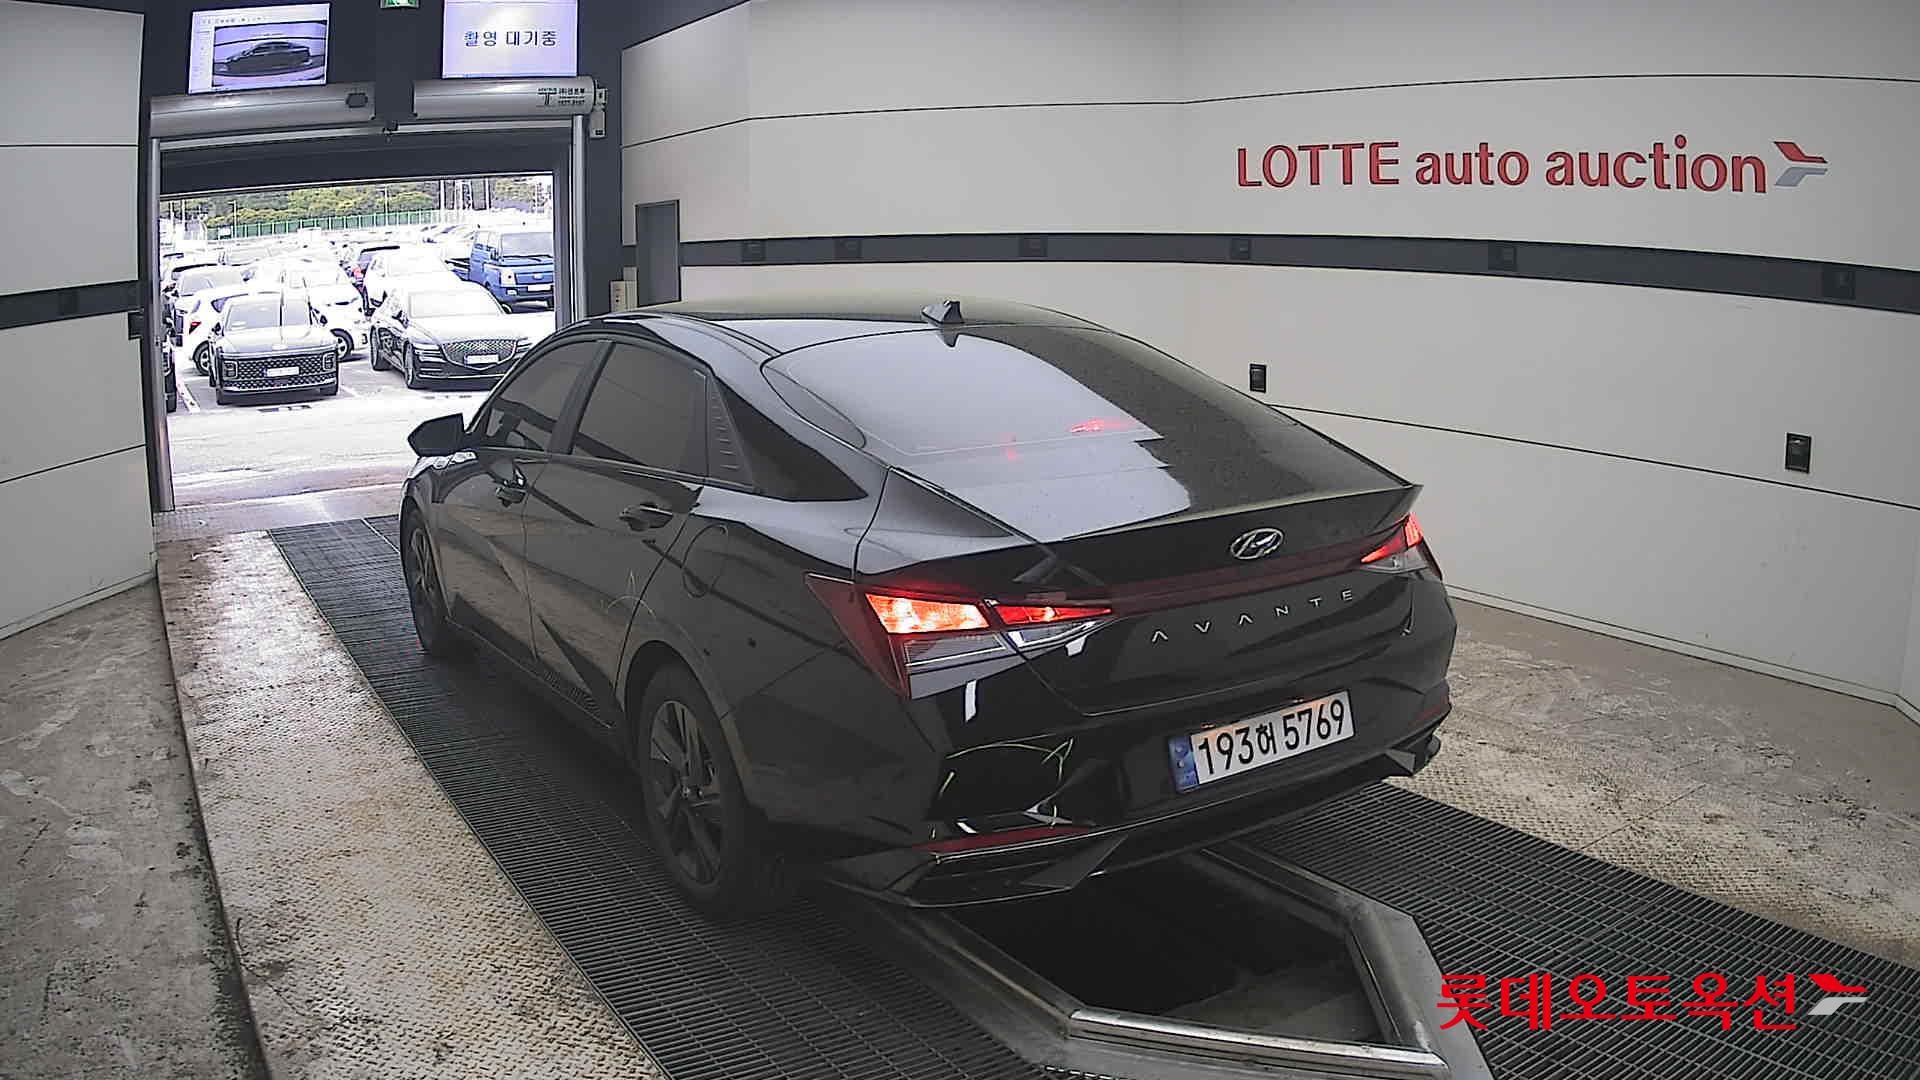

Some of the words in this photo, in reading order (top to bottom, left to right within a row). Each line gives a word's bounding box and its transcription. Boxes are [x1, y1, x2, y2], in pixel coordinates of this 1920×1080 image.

[505, 30, 557, 47] 대기중
[1237, 141, 1400, 189] LOTTE
[1415, 142, 1530, 187] auto
[1545, 134, 1768, 194] auction
[1151, 589, 1354, 643] AVANTE
[1198, 722, 1278, 775] 193허
[1281, 698, 1346, 751] 5769
